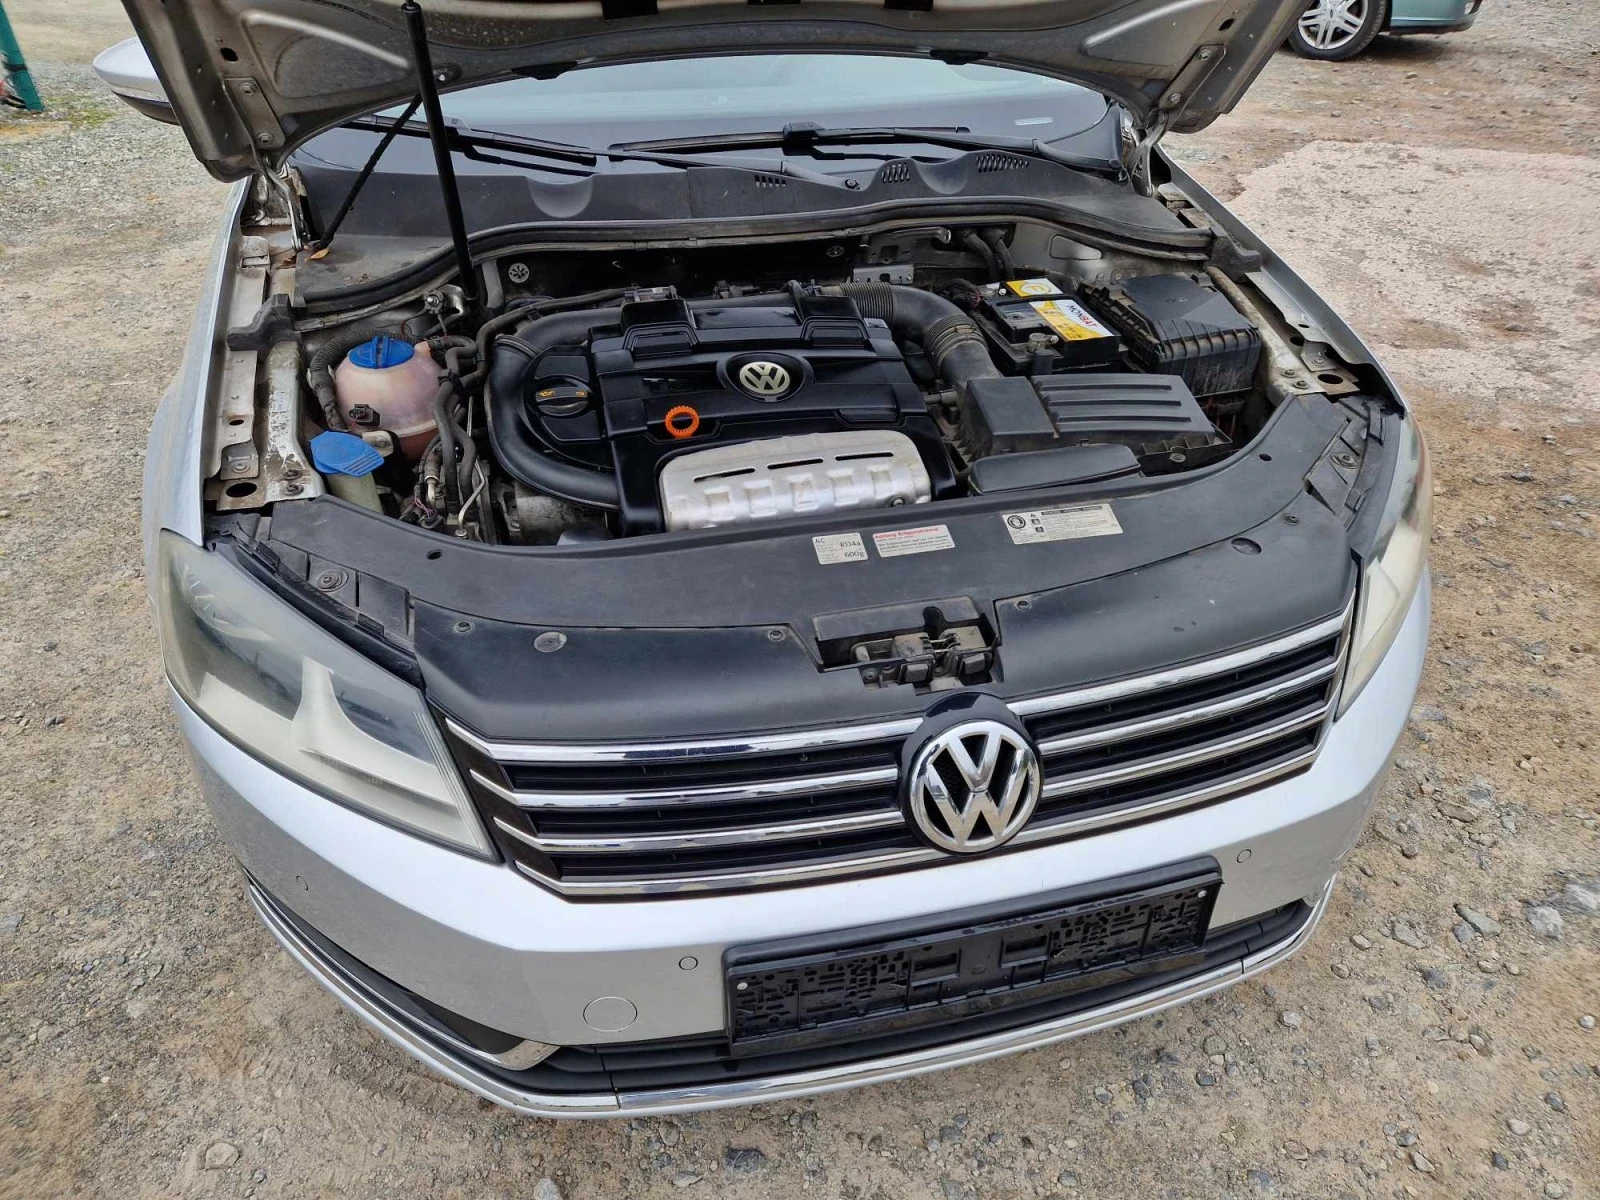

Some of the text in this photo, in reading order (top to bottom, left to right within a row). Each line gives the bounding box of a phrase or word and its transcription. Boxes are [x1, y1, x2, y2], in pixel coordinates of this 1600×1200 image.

[1067, 305, 1097, 327] MONBAT
[739, 361, 791, 395] VW
[910, 720, 1041, 853] VW
